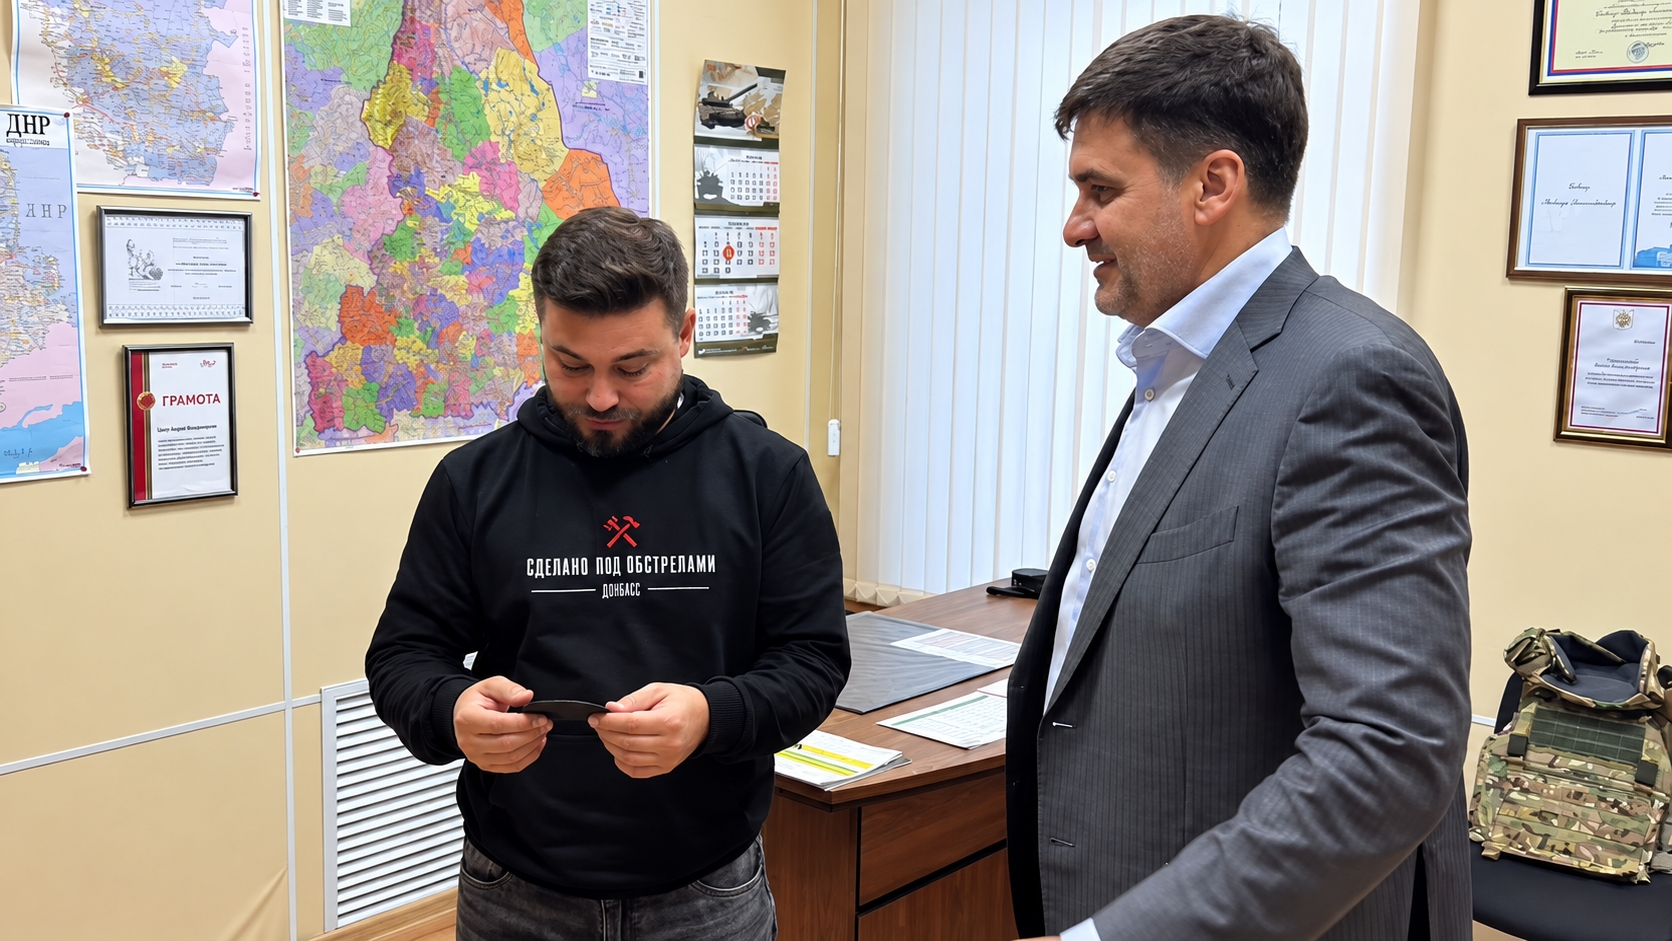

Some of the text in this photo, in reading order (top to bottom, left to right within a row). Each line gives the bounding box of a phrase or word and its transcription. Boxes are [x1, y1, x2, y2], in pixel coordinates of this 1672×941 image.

[6, 113, 51, 138] ДНР
[163, 394, 221, 406] ГРАМОТА
[526, 554, 716, 579] СДЕЛАНО ПОД ОБСТРЕЛАМИ
[602, 582, 641, 599] ДОНБАСС
